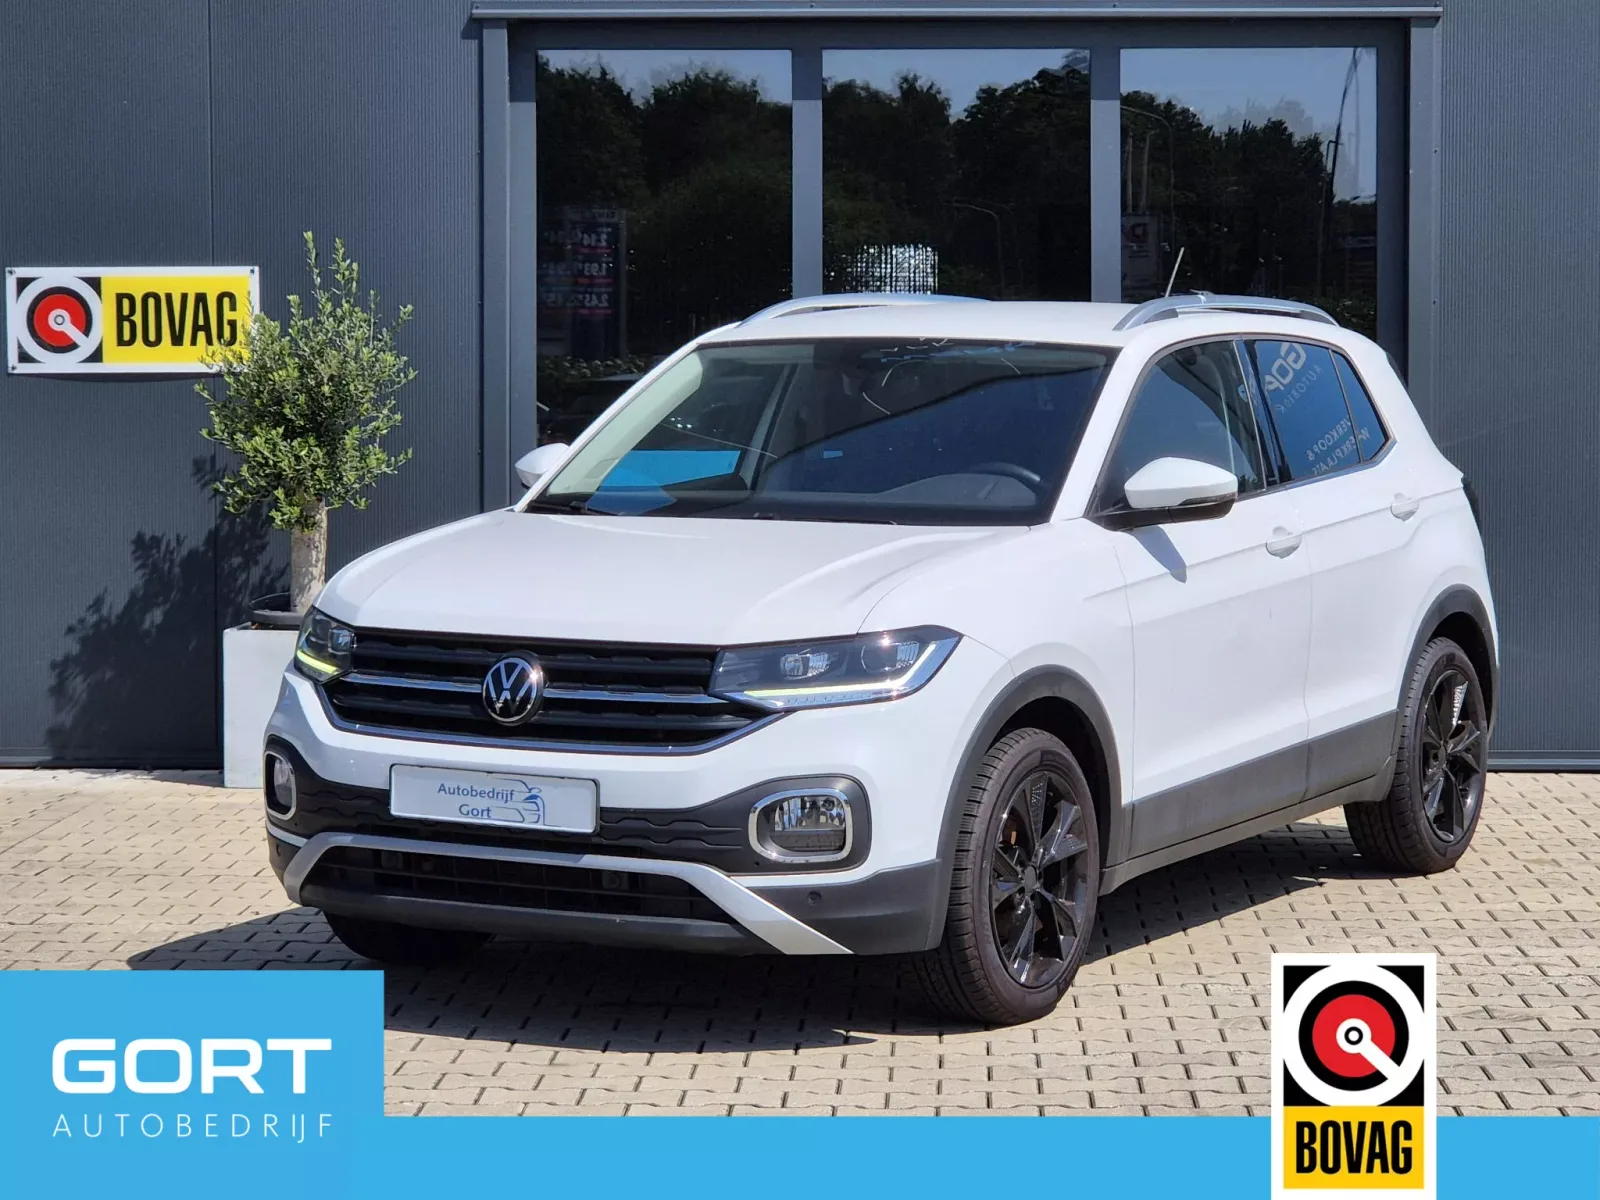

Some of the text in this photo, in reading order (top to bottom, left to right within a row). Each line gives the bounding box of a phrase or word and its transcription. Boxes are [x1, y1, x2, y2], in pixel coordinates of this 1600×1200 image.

[115, 291, 238, 348] BOVAG
[437, 782, 515, 804] Autobedrijf
[458, 804, 492, 819] Gort
